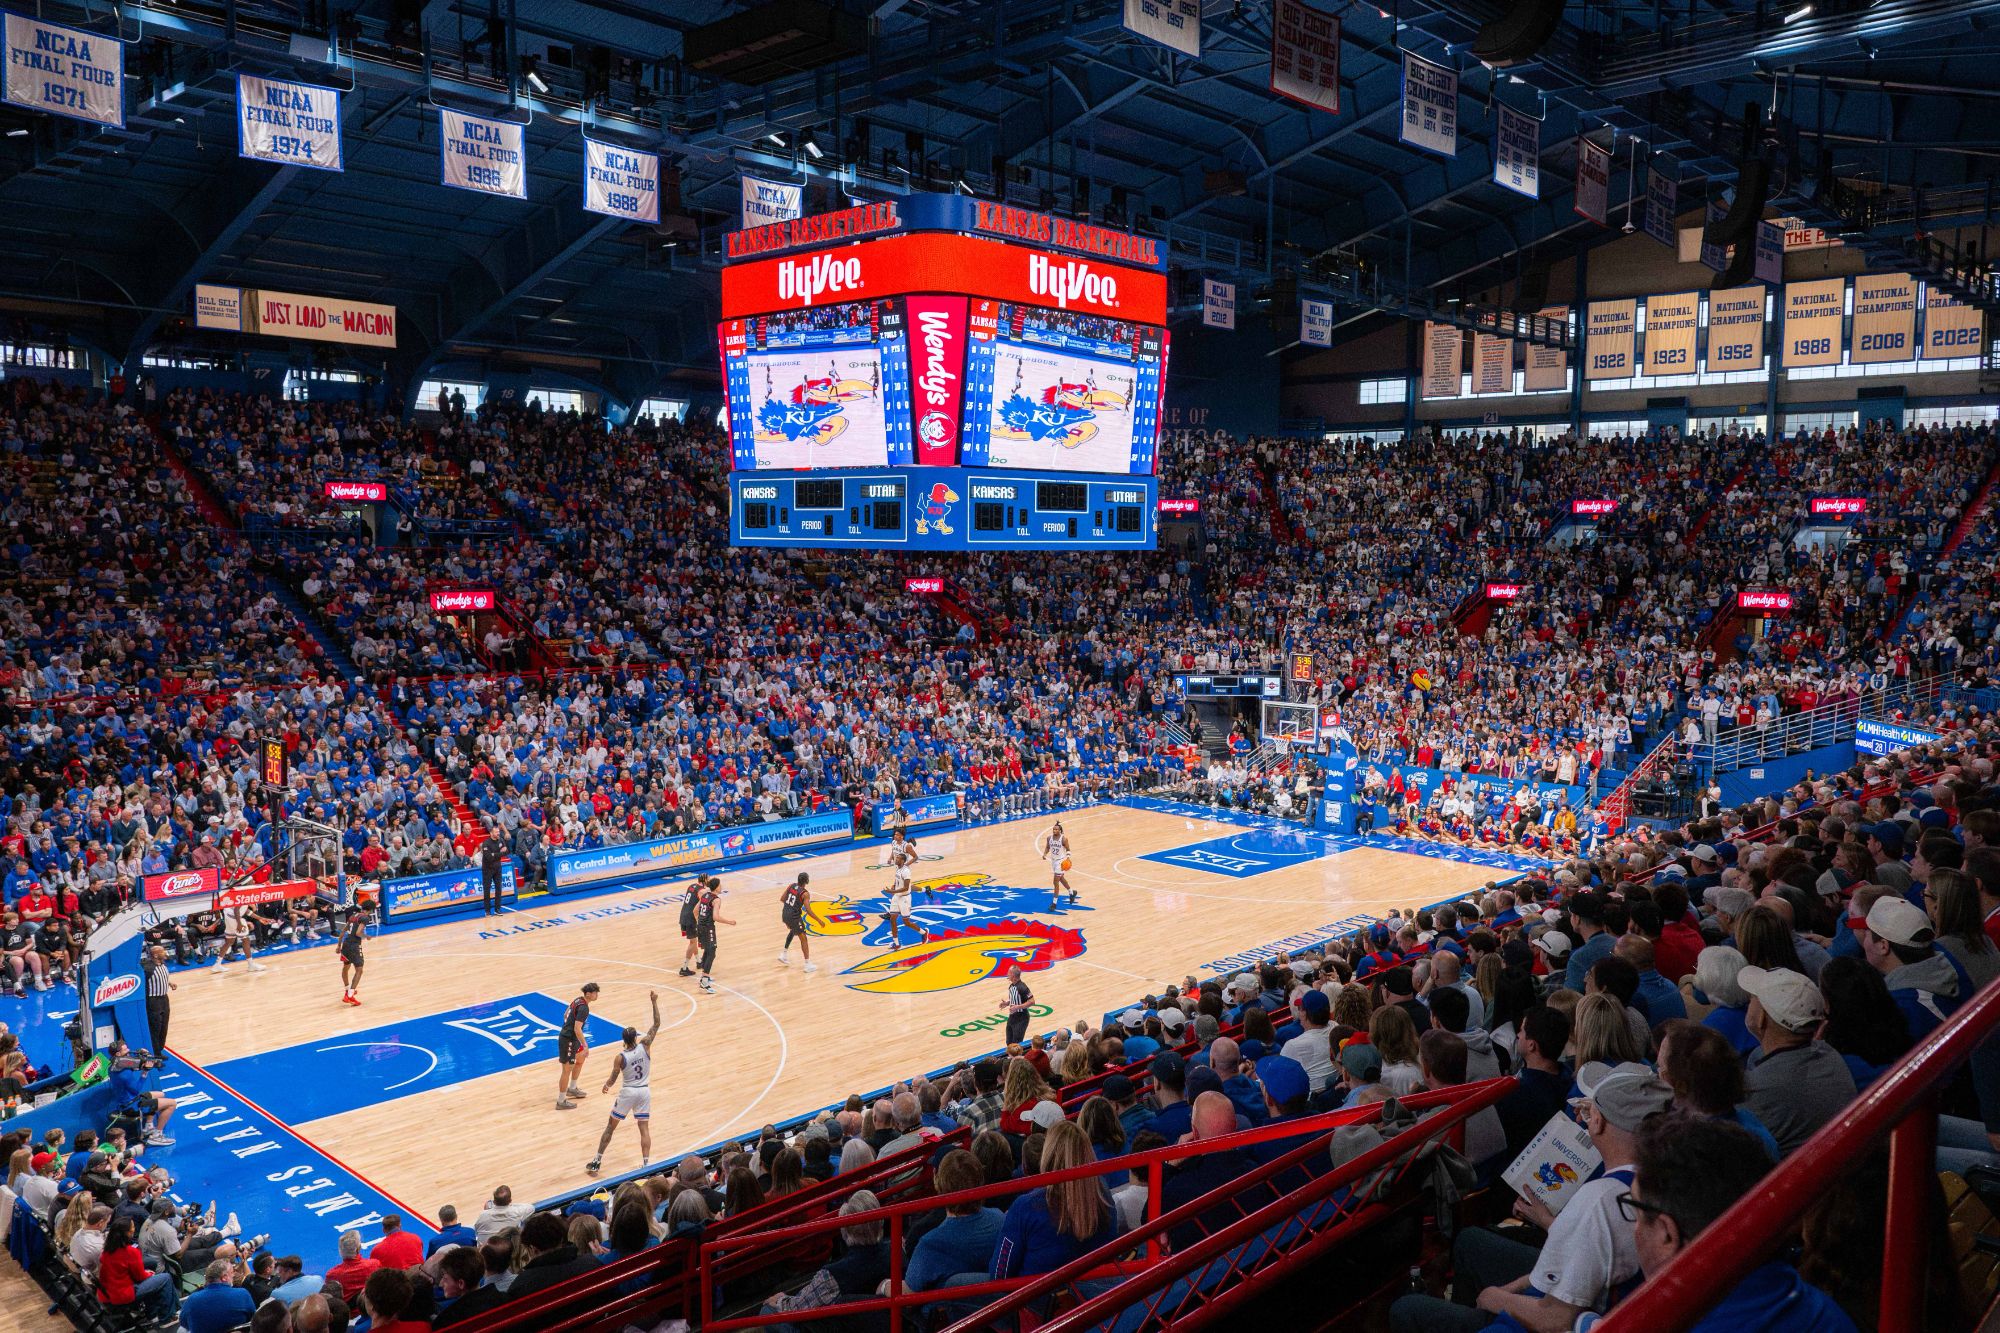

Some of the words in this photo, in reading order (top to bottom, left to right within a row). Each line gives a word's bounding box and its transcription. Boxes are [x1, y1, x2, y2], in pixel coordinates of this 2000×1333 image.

[1168, 12, 1184, 29] 1957
[35, 29, 91, 61] NCAA
[12, 48, 65, 75] FINAL
[71, 62, 115, 87] FOUR
[1411, 61, 1426, 81] BIG
[1427, 69, 1452, 91] EIGHT
[43, 82, 87, 110] 1971
[266, 87, 313, 112] NCAA
[1407, 79, 1455, 110] CHAMPIONS
[247, 106, 291, 127] FINAL
[296, 115, 333, 134] FOUR
[1424, 119, 1436, 132] 1974
[463, 121, 502, 145] NCAA
[272, 135, 312, 158] 1974
[448, 138, 484, 158] FINAL
[489, 147, 518, 164] FOUR
[605, 152, 640, 174] NCAA
[467, 165, 501, 186] 1986
[591, 167, 623, 186] FINAL
[628, 176, 655, 192] FOUR
[607, 192, 638, 212] 1988
[757, 186, 787, 205] NCAA
[746, 200, 773, 217] FINAL
[776, 207, 798, 220] FOUR
[728, 222, 786, 257] KANSAS
[790, 200, 897, 245] BASKETBALL
[977, 201, 1050, 241] KANSAS
[1056, 220, 1160, 264] BASKETBALL
[1786, 230, 1811, 244] THE
[779, 254, 861, 305] HyVee
[1029, 254, 1117, 308] HyVee
[1792, 293, 1837, 306] NATIONAL
[1862, 287, 1910, 300] NATIONAL
[198, 297, 216, 305] BILL
[219, 299, 237, 307] SELF
[1716, 300, 1759, 312] NATIONAL
[1856, 300, 1914, 314] CHAMPIONS
[263, 301, 290, 324] JUST
[296, 305, 326, 328] LOAD
[328, 314, 342, 324] THE
[343, 311, 393, 336] WAGON
[882, 314, 900, 326] UTAH
[1593, 312, 1630, 323] NATIONAL
[1653, 306, 1692, 318] NATIONAL
[1711, 313, 1763, 326] CHAMPIONS
[1786, 306, 1841, 320] CHAMPIONS
[971, 316, 997, 328] KANSAS
[1647, 319, 1696, 331] CHAMPIONS
[1588, 325, 1633, 336] CHAMPIONS
[1932, 328, 1980, 346] 2022
[1143, 341, 1158, 351] UTAH
[1793, 338, 1831, 355] 1988
[1861, 333, 1905, 351] 2008
[918, 311, 957, 406] Wendy's
[1653, 349, 1687, 365] 1923
[1718, 344, 1753, 360] 1952
[1593, 353, 1625, 369] 1922
[500, 388, 515, 400] 18
[783, 410, 815, 425] KU
[1030, 410, 1065, 426] KU
[1486, 412, 1497, 422] 21
[964, 423, 971, 431] 22
[331, 484, 364, 498] Wendy's
[743, 487, 776, 499] KANSAS
[869, 485, 895, 497] UTAH
[974, 486, 1014, 499] KANSAS
[1113, 492, 1136, 503] UTAH
[1161, 501, 1184, 511] Wendy's
[1576, 501, 1601, 513] Wendy's
[1816, 500, 1846, 512] Wendy's
[801, 521, 822, 530] PERIOD
[1043, 523, 1065, 532] PERIOD
[1490, 586, 1517, 598] Wendy's
[436, 593, 472, 610] Wendy's
[1743, 594, 1776, 608] Wendy's
[1295, 665, 1310, 678] 26
[1864, 723, 1879, 736] LMH
[1879, 727, 1901, 740] Health
[1875, 743, 1883, 752] 28
[267, 758, 280, 784] 26
[757, 829, 803, 844] JAYHAWK
[804, 821, 849, 837] CHECKING
[1592, 826, 1600, 834] KU
[650, 840, 689, 858] WAVE
[691, 837, 708, 847] THE
[671, 844, 717, 865] WHEAT
[1052, 848, 1060, 856] 22
[574, 855, 607, 870] Central
[608, 852, 631, 864] Bank
[1425, 850, 1537, 871] COURT
[164, 873, 201, 894] Cane's
[397, 882, 415, 891] Central
[425, 887, 437, 895] THE
[234, 893, 260, 905] State
[260, 891, 284, 901] Farm
[685, 892, 691, 904] 8
[786, 893, 796, 907] 13
[140, 912, 161, 926] KU
[1316, 913, 1377, 934] ALLEN
[478, 917, 569, 940] ALLEN
[1200, 931, 1328, 973] FIELDHOUSE
[96, 978, 135, 1004] LIBMAN
[634, 1065, 643, 1080] 3
[1510, 1131, 1548, 1173] POPCORN
[1551, 1137, 1592, 1173] UNIVERSITY
